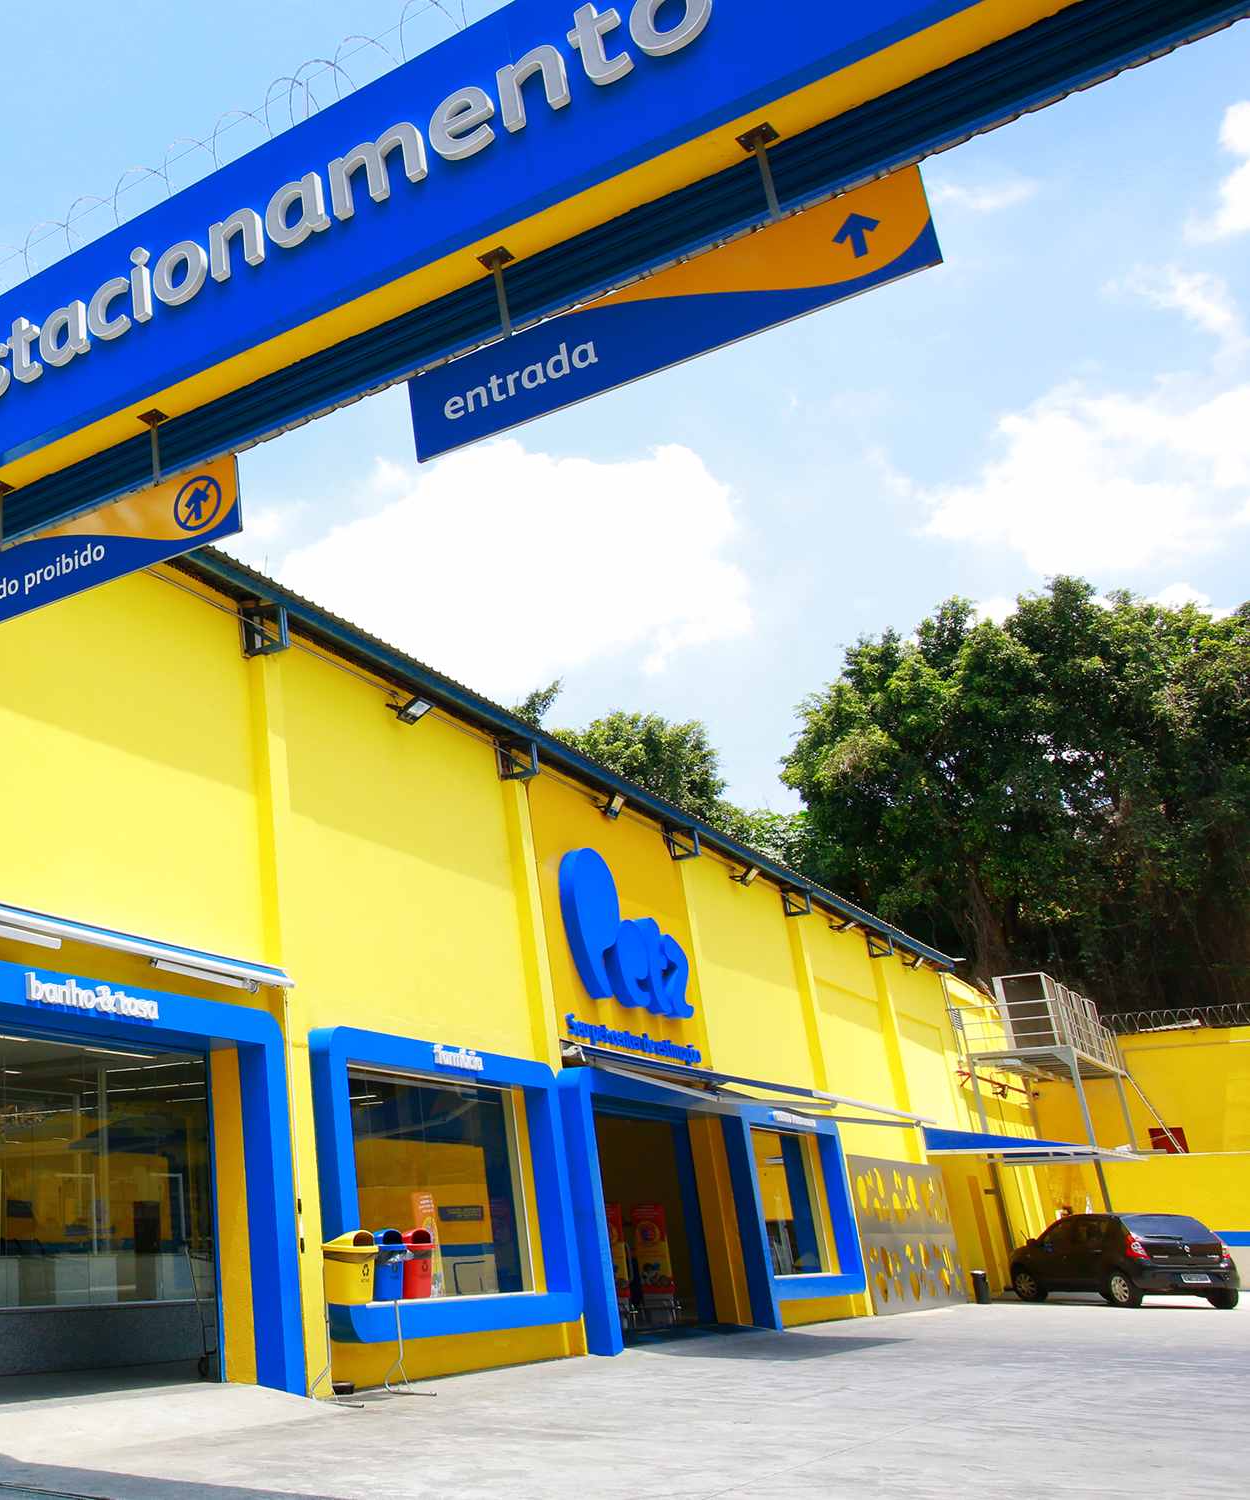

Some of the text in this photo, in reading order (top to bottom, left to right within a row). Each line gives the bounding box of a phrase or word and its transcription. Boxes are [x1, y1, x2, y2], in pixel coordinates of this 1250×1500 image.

[442, 337, 599, 421] entrada
[24, 542, 105, 595] proibido
[24, 972, 95, 1009] banho
[114, 991, 160, 1020] tosa
